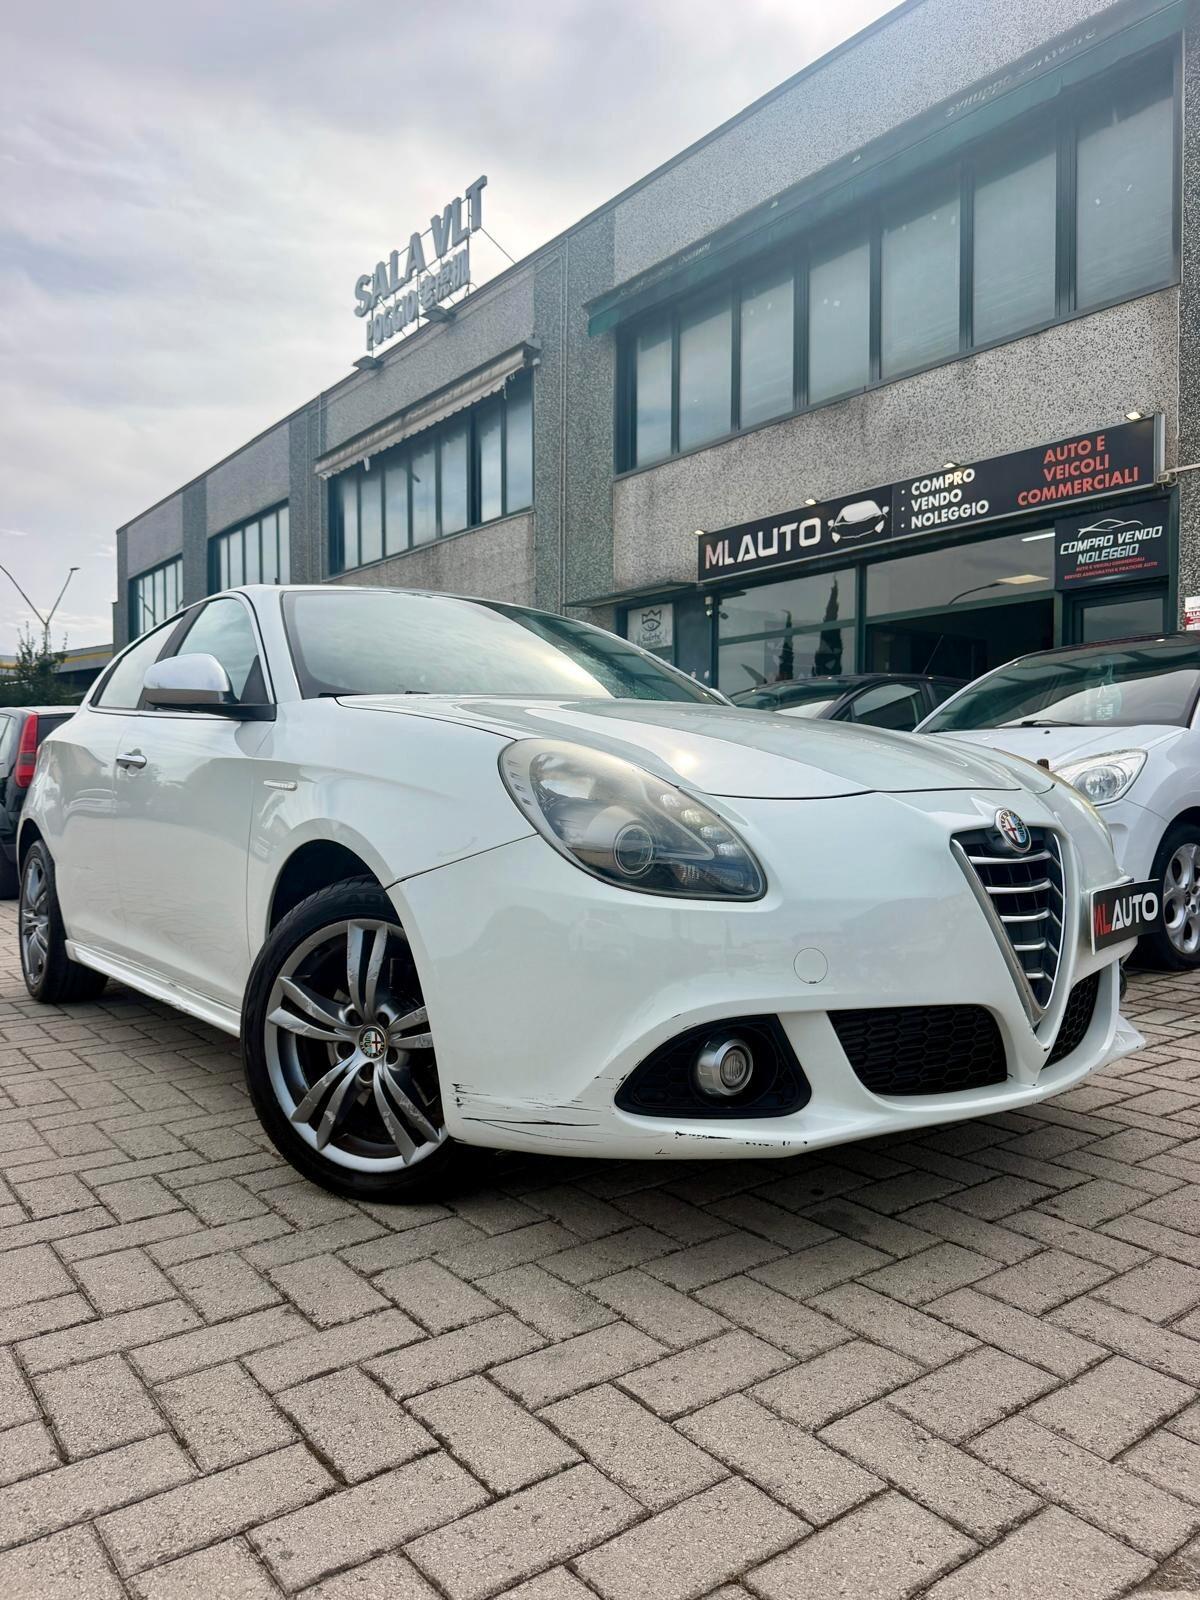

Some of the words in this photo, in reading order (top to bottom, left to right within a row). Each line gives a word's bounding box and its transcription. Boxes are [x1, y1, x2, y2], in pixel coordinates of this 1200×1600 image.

[354, 231, 426, 318] SALA
[430, 174, 488, 259] VLT
[366, 290, 419, 351] POGGIO
[1043, 439, 1092, 465] AUTO
[1096, 434, 1106, 451] E
[911, 467, 976, 496] COMPRO
[1043, 453, 1110, 482] VEICOLI
[911, 488, 963, 513] VENDO
[1017, 465, 1140, 507] COMMERCIALI
[911, 500, 990, 530] NOLEGGIO
[1060, 534, 1114, 555] COMPRO
[1117, 525, 1163, 545] VENDO
[1077, 543, 1140, 565] NOLEGGIO
